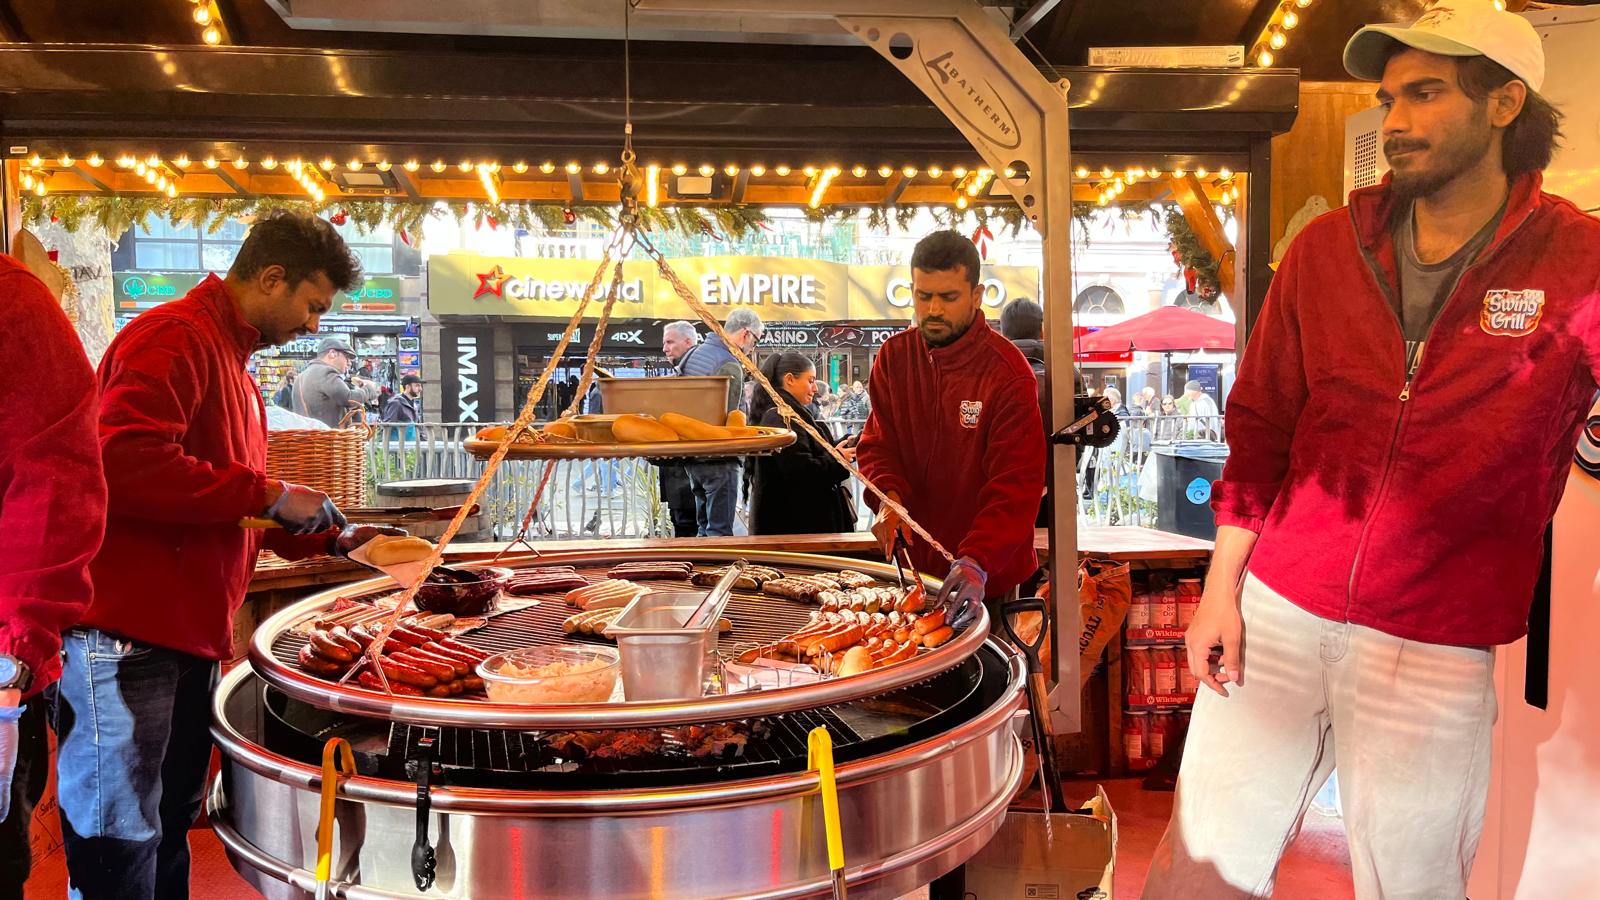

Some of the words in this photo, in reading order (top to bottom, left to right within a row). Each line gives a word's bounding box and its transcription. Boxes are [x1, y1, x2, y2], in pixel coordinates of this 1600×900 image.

[926, 51, 1011, 136] LIBATHERM
[366, 288, 393, 298] CBD
[700, 273, 816, 305] EMPIRE
[1488, 293, 1538, 317] Swing
[1491, 311, 1526, 330] Grill
[611, 329, 645, 345] 4DX
[456, 336, 479, 422] IMAX
[1155, 696, 1189, 704] Wikinger
